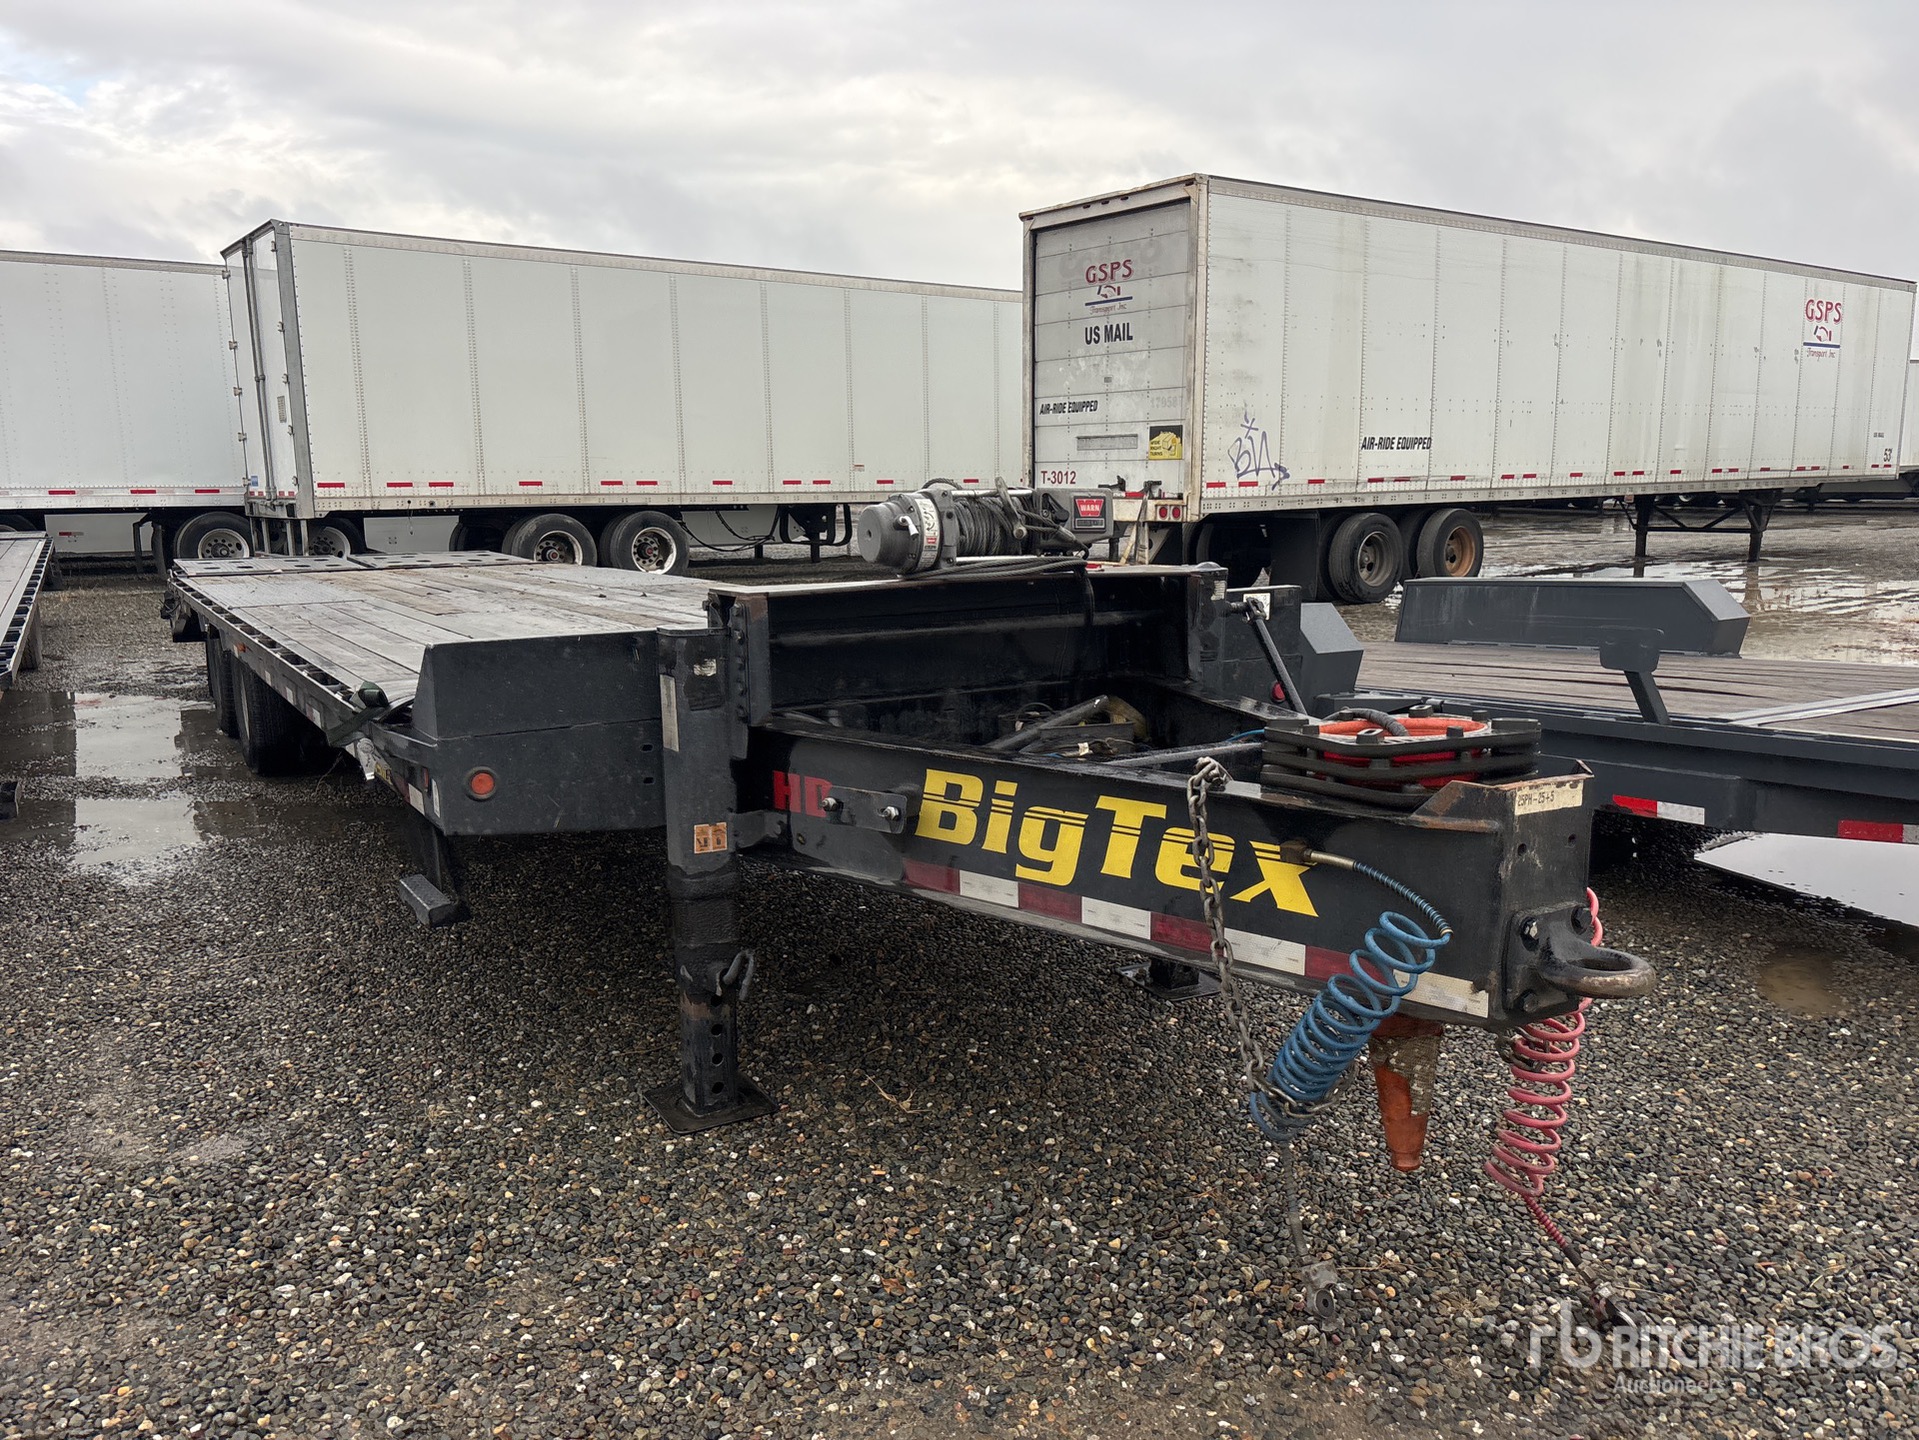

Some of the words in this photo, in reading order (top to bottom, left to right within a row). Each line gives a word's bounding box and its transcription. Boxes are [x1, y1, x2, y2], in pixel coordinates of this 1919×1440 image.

[1086, 259, 1134, 284] GSPS
[1805, 299, 1842, 323] GSPS
[1085, 325, 1101, 345] US
[1104, 322, 1134, 343] MAIL
[1039, 402, 1067, 415] AIR-RIDE
[1068, 400, 1098, 413] EQUIPPED
[1361, 437, 1395, 450] AIR-RIDE
[1396, 437, 1432, 450] EQUIPPED
[1041, 470, 1076, 485] T-3012
